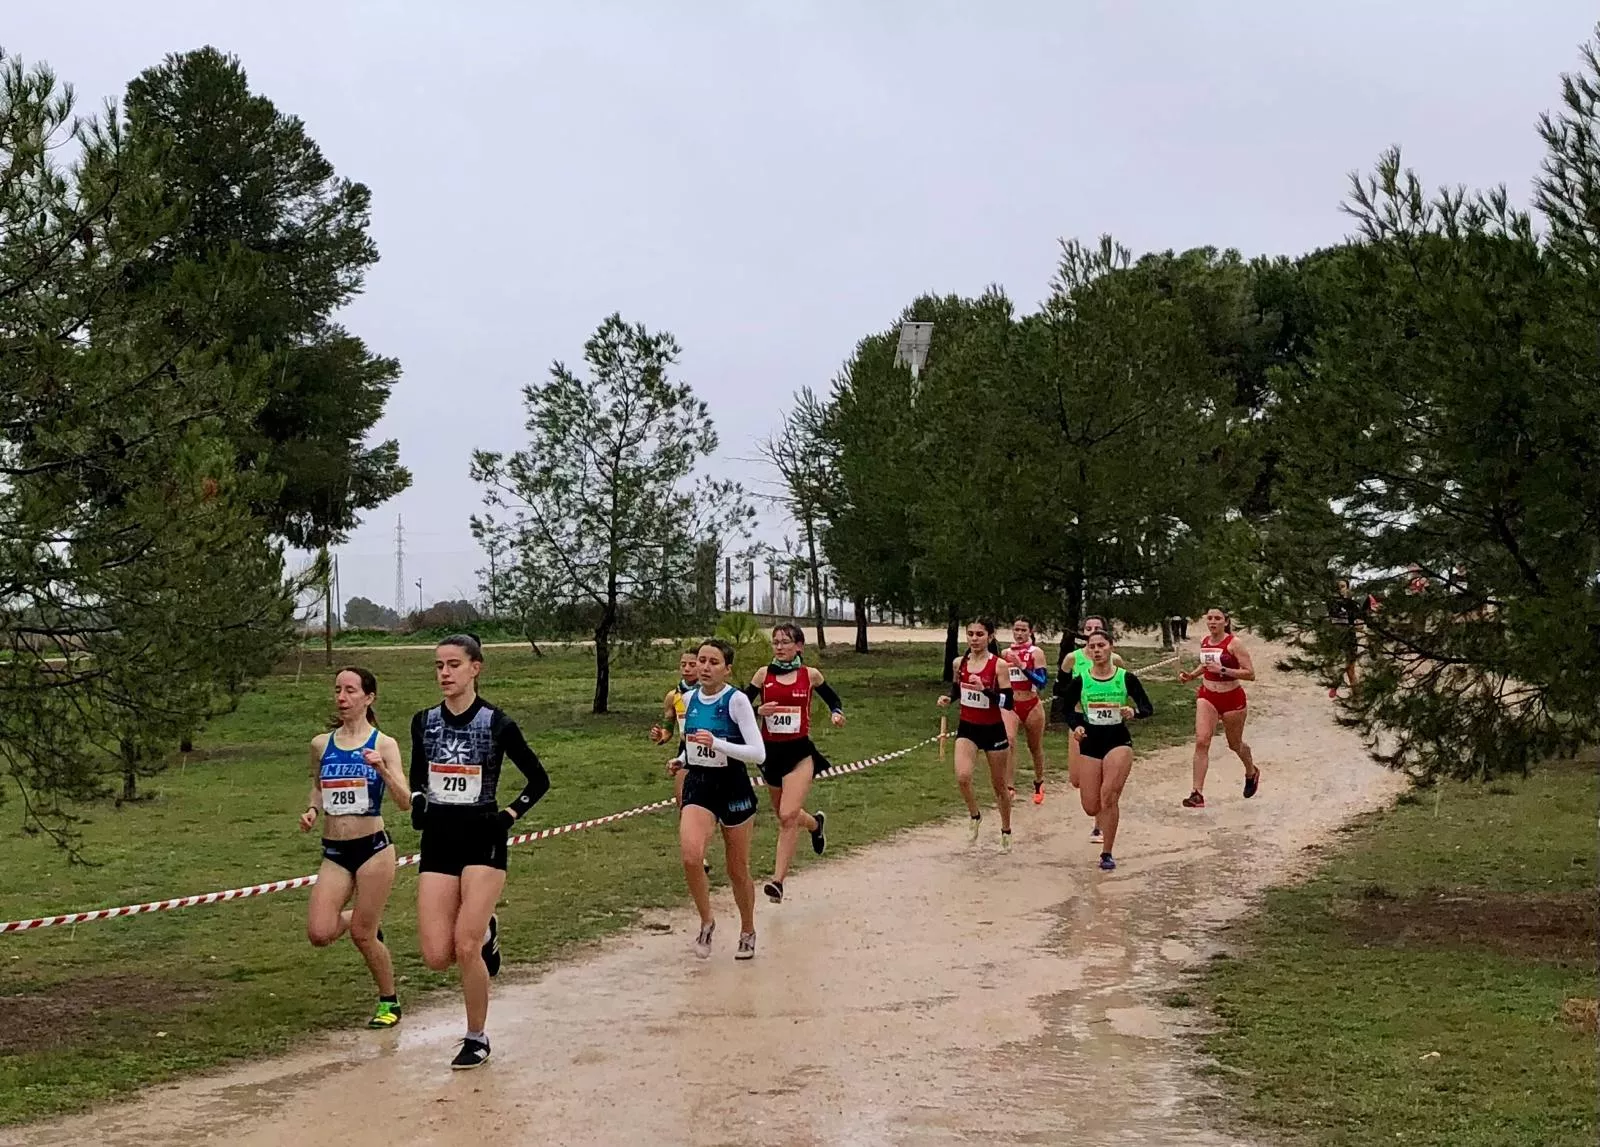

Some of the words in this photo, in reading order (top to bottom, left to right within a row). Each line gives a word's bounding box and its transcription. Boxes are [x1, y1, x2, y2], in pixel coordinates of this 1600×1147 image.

[967, 692, 980, 701] 241
[1096, 710, 1113, 719] 242
[773, 715, 792, 726] 240
[443, 776, 467, 792] 279
[332, 790, 356, 805] 289
